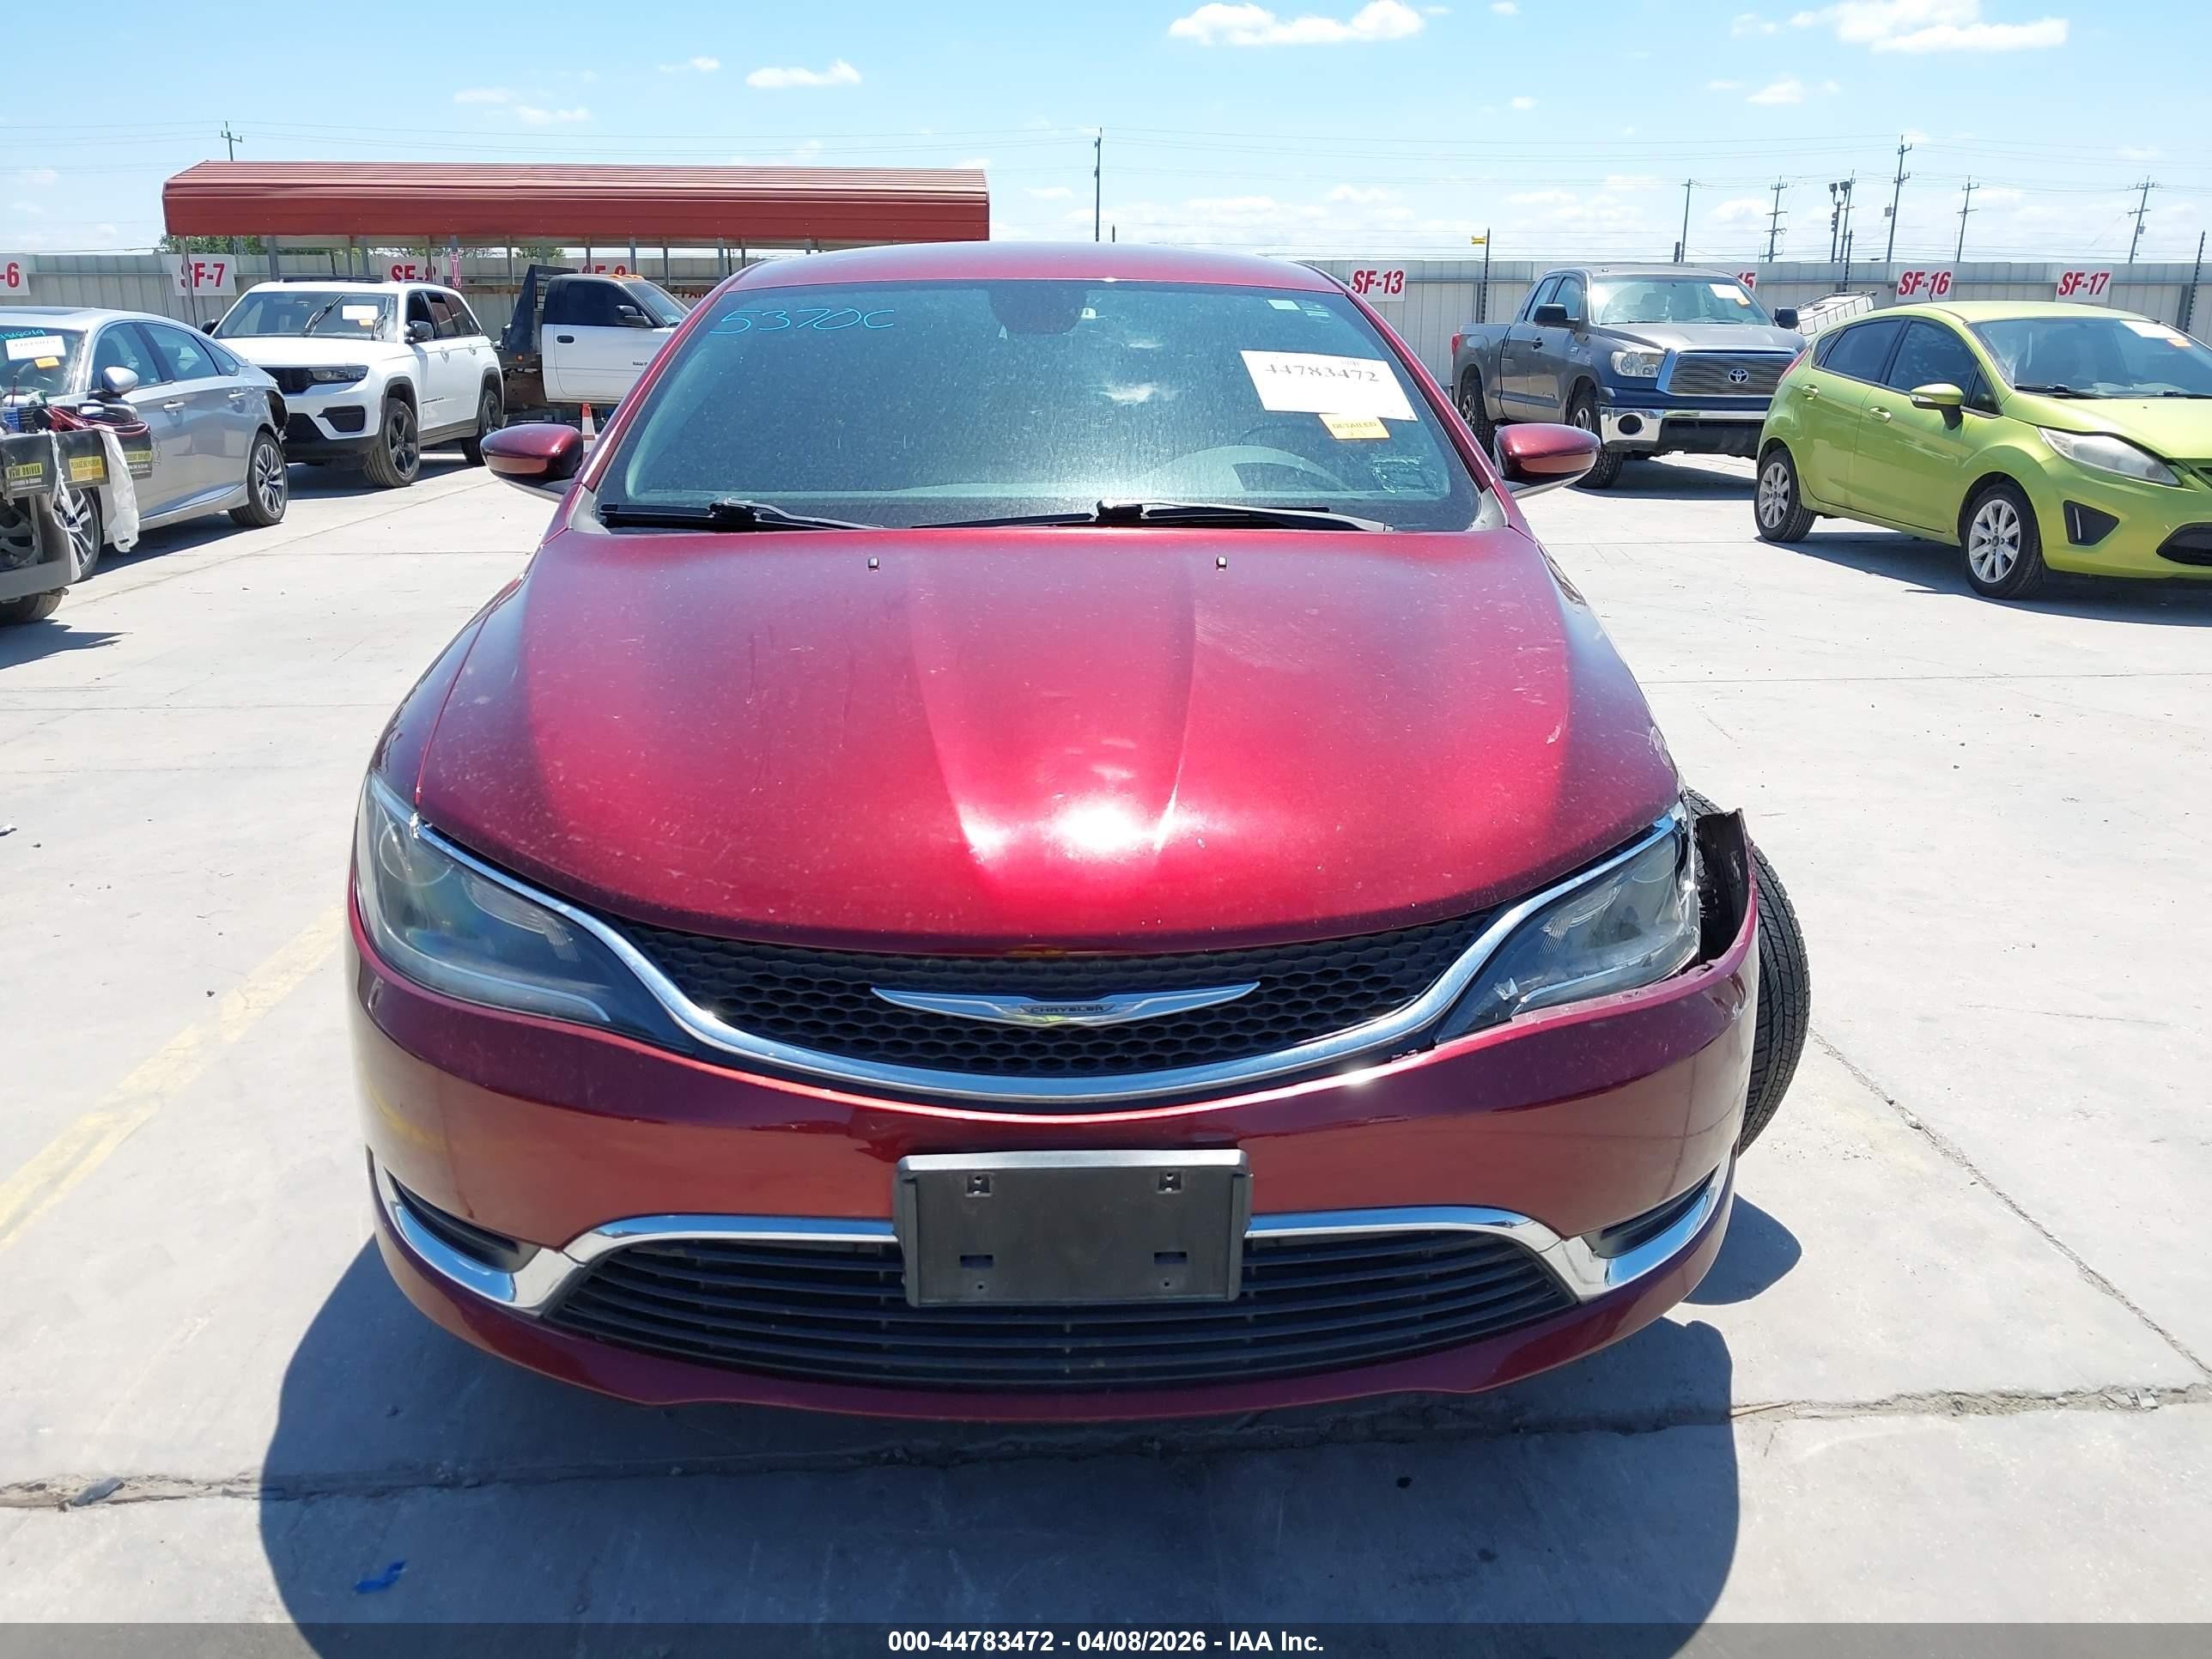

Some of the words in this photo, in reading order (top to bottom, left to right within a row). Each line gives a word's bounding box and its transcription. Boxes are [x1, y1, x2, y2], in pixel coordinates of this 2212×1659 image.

[1351, 270, 1405, 295] SF-13
[1898, 271, 1952, 296] SF-16
[2057, 271, 2111, 296] SF-17
[709, 307, 896, 335] 5370C
[1266, 364, 1379, 381] 44783472
[1031, 1004, 1104, 1013] CHRYSLER
